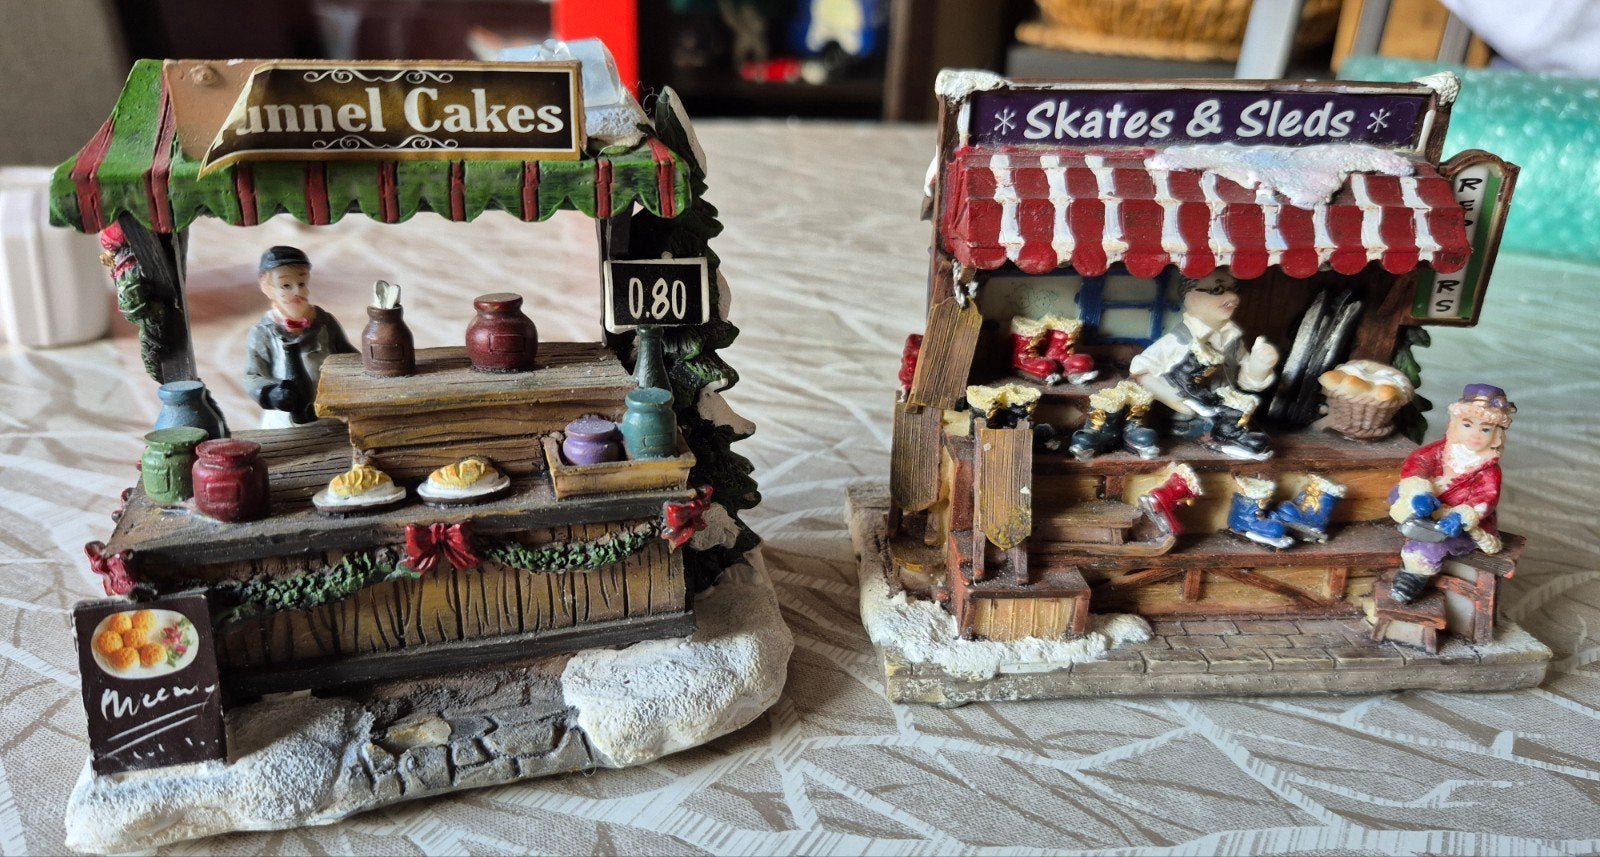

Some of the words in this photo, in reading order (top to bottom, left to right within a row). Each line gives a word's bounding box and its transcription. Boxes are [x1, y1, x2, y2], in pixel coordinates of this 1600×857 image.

[233, 87, 387, 136] unnel
[404, 86, 564, 134] Cakes
[1023, 100, 1172, 140] Skates
[1186, 99, 1222, 138] &
[1236, 100, 1354, 138] Sleds
[628, 277, 687, 320] 0.80
